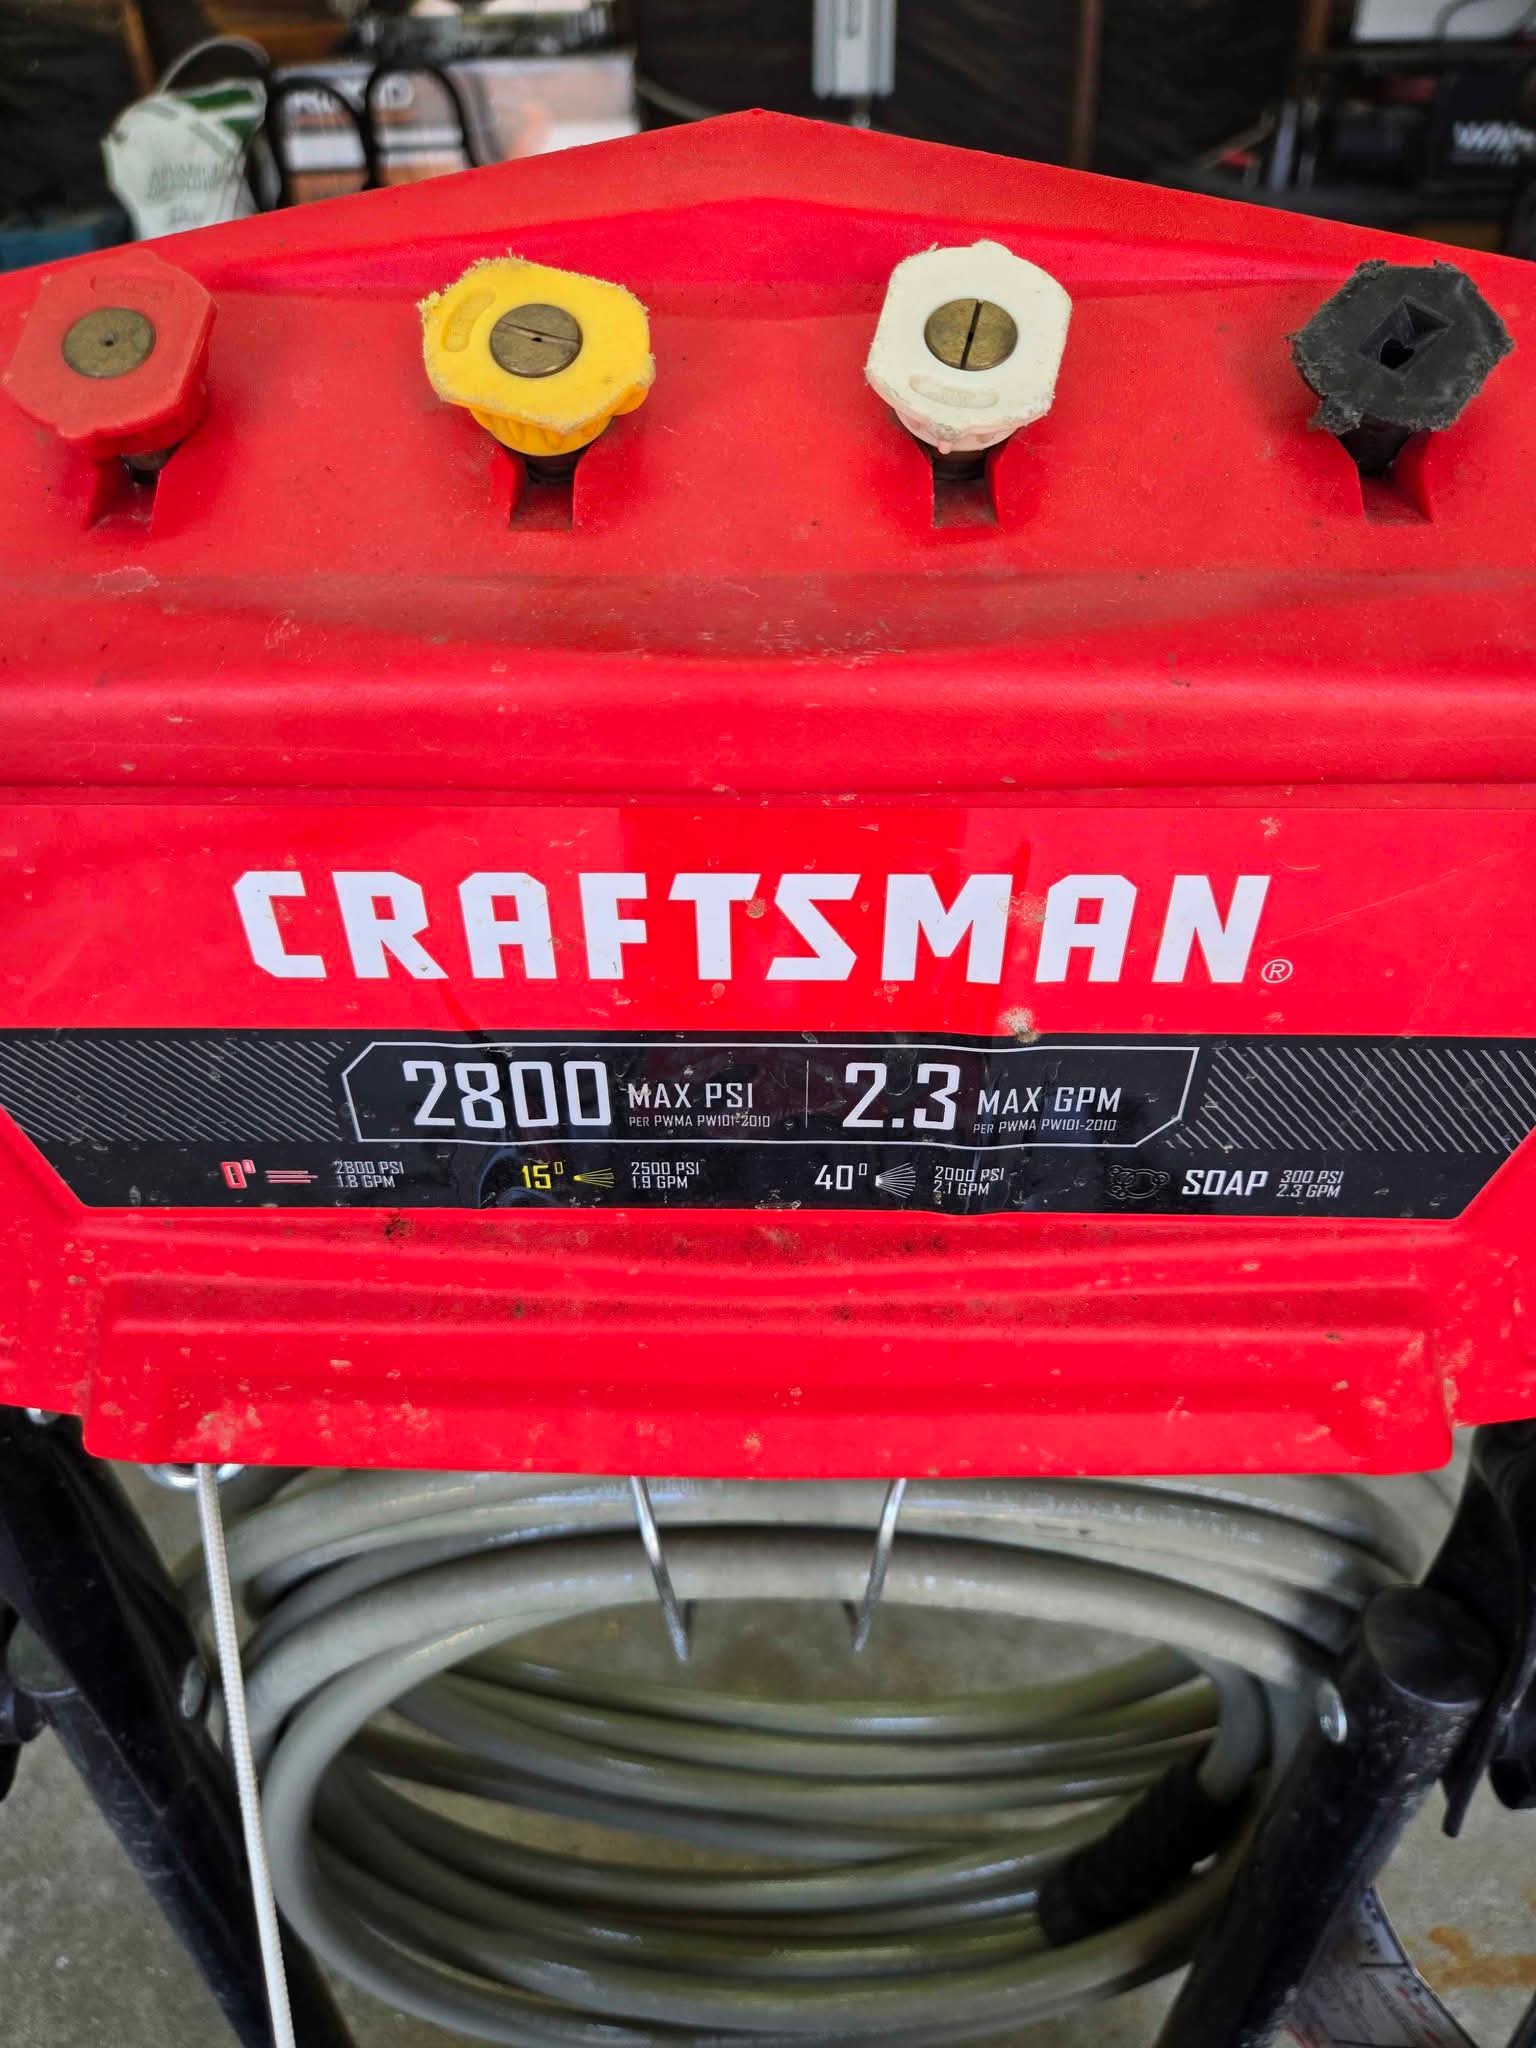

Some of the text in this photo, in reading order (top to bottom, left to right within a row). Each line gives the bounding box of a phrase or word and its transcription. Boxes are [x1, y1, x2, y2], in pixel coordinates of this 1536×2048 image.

[402, 1060, 612, 1129] 2800
[627, 1083, 753, 1109] MAX PSI
[842, 1062, 961, 1131] 2.3
[977, 1086, 1121, 1115] MAX GPM
[628, 1116, 650, 1128] PER
[654, 1115, 694, 1128] PWMA
[973, 1118, 1117, 1135] PER PWMA PW101-2010
[335, 1160, 405, 1175] 2800 PSI
[631, 1161, 701, 1176] 2500 PSI
[934, 1165, 1005, 1182] 2000 PSI
[338, 1175, 396, 1188] 1.8 GPM
[632, 1175, 688, 1189] 1.9 GPM
[1181, 1169, 1269, 1197] SOAP
[1280, 1169, 1344, 1185] 300 PSI
[932, 1180, 990, 1196] 2.1 GPM
[1276, 1184, 1341, 1199] 2.3 GPM
